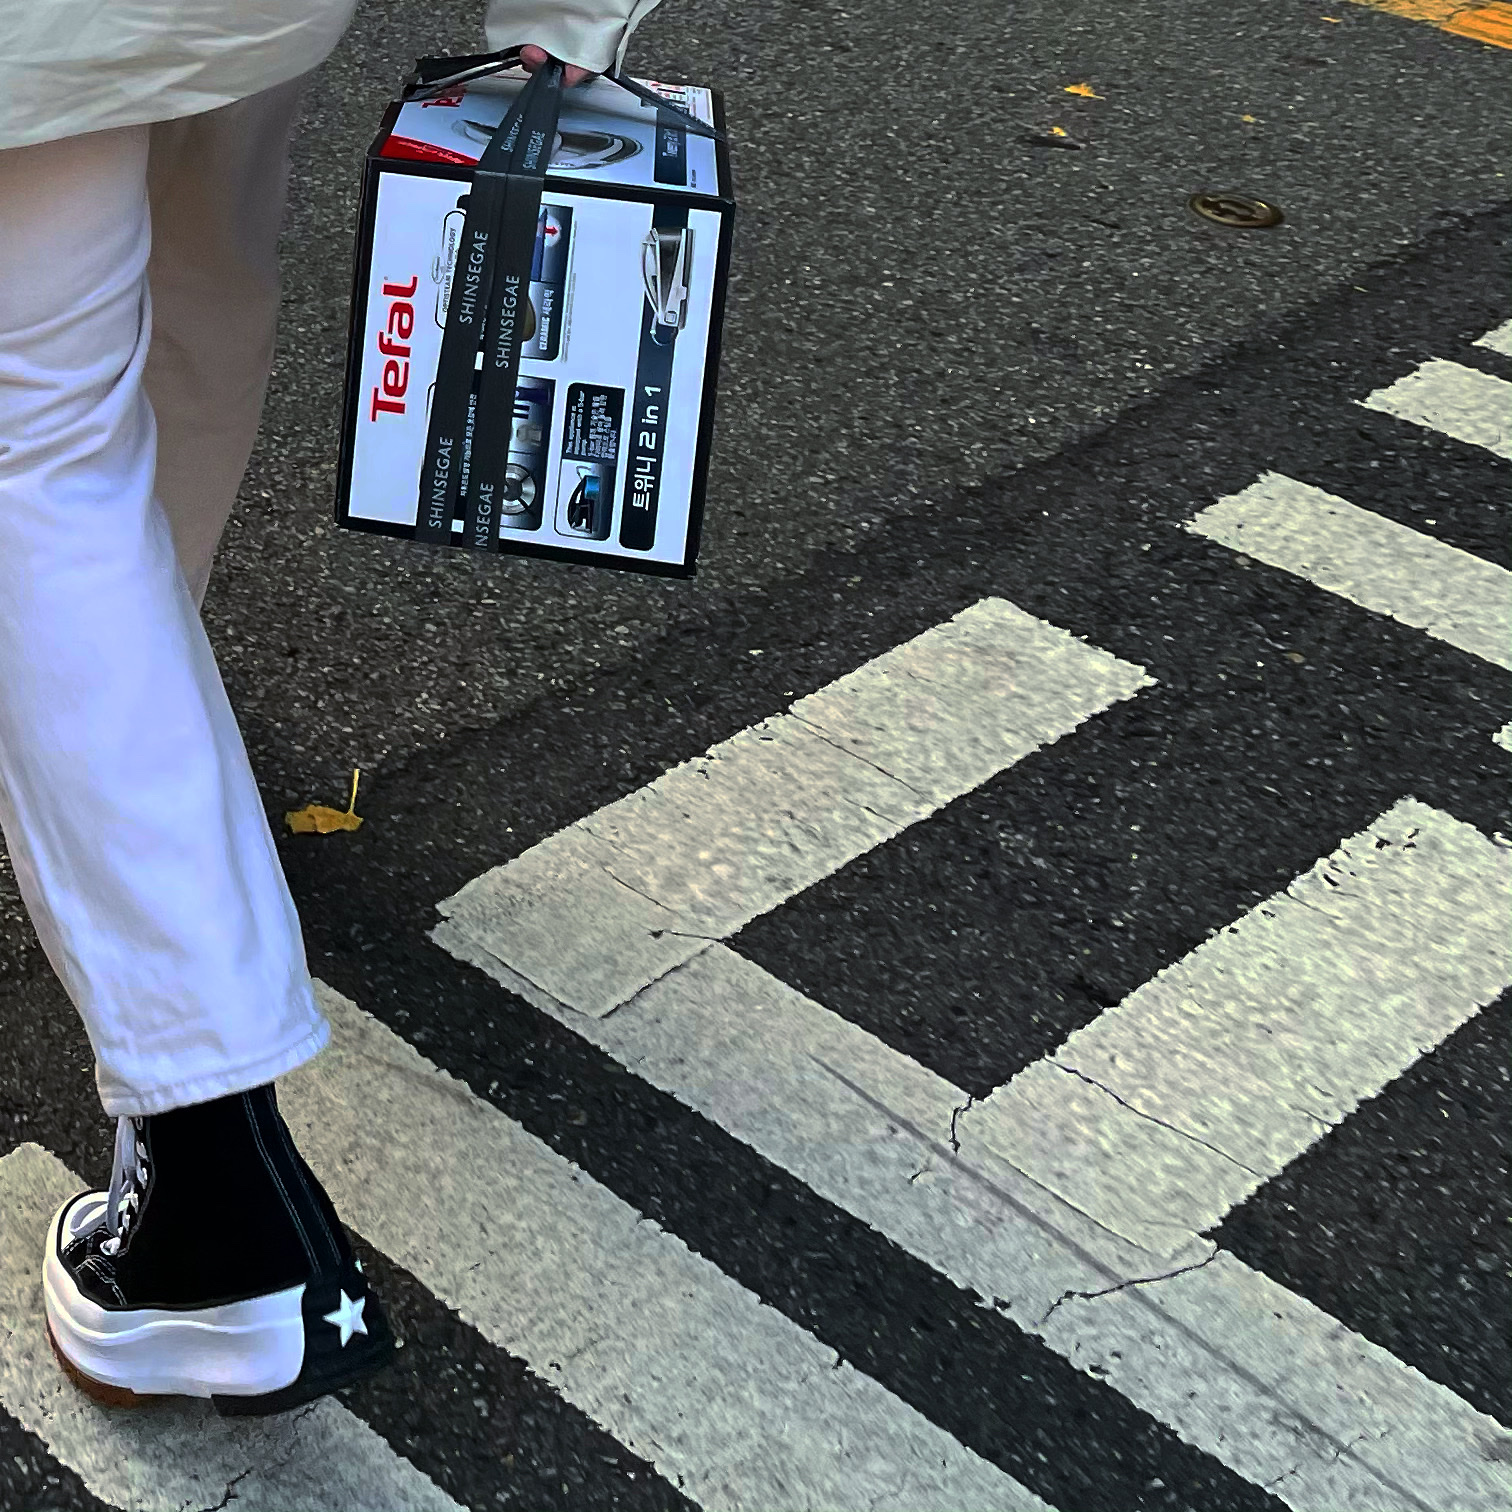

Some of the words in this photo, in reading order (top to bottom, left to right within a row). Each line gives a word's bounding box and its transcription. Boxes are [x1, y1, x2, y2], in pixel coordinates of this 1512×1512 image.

[460, 231, 488, 325] SHINSEGAE
[370, 276, 418, 422] Tefal
[495, 274, 520, 369] SHINSEGAE
[641, 405, 659, 425] in
[644, 386, 662, 397] 1
[639, 431, 657, 449] 2
[429, 436, 454, 529] SHINSEGAE
[632, 455, 657, 511] 트위니
